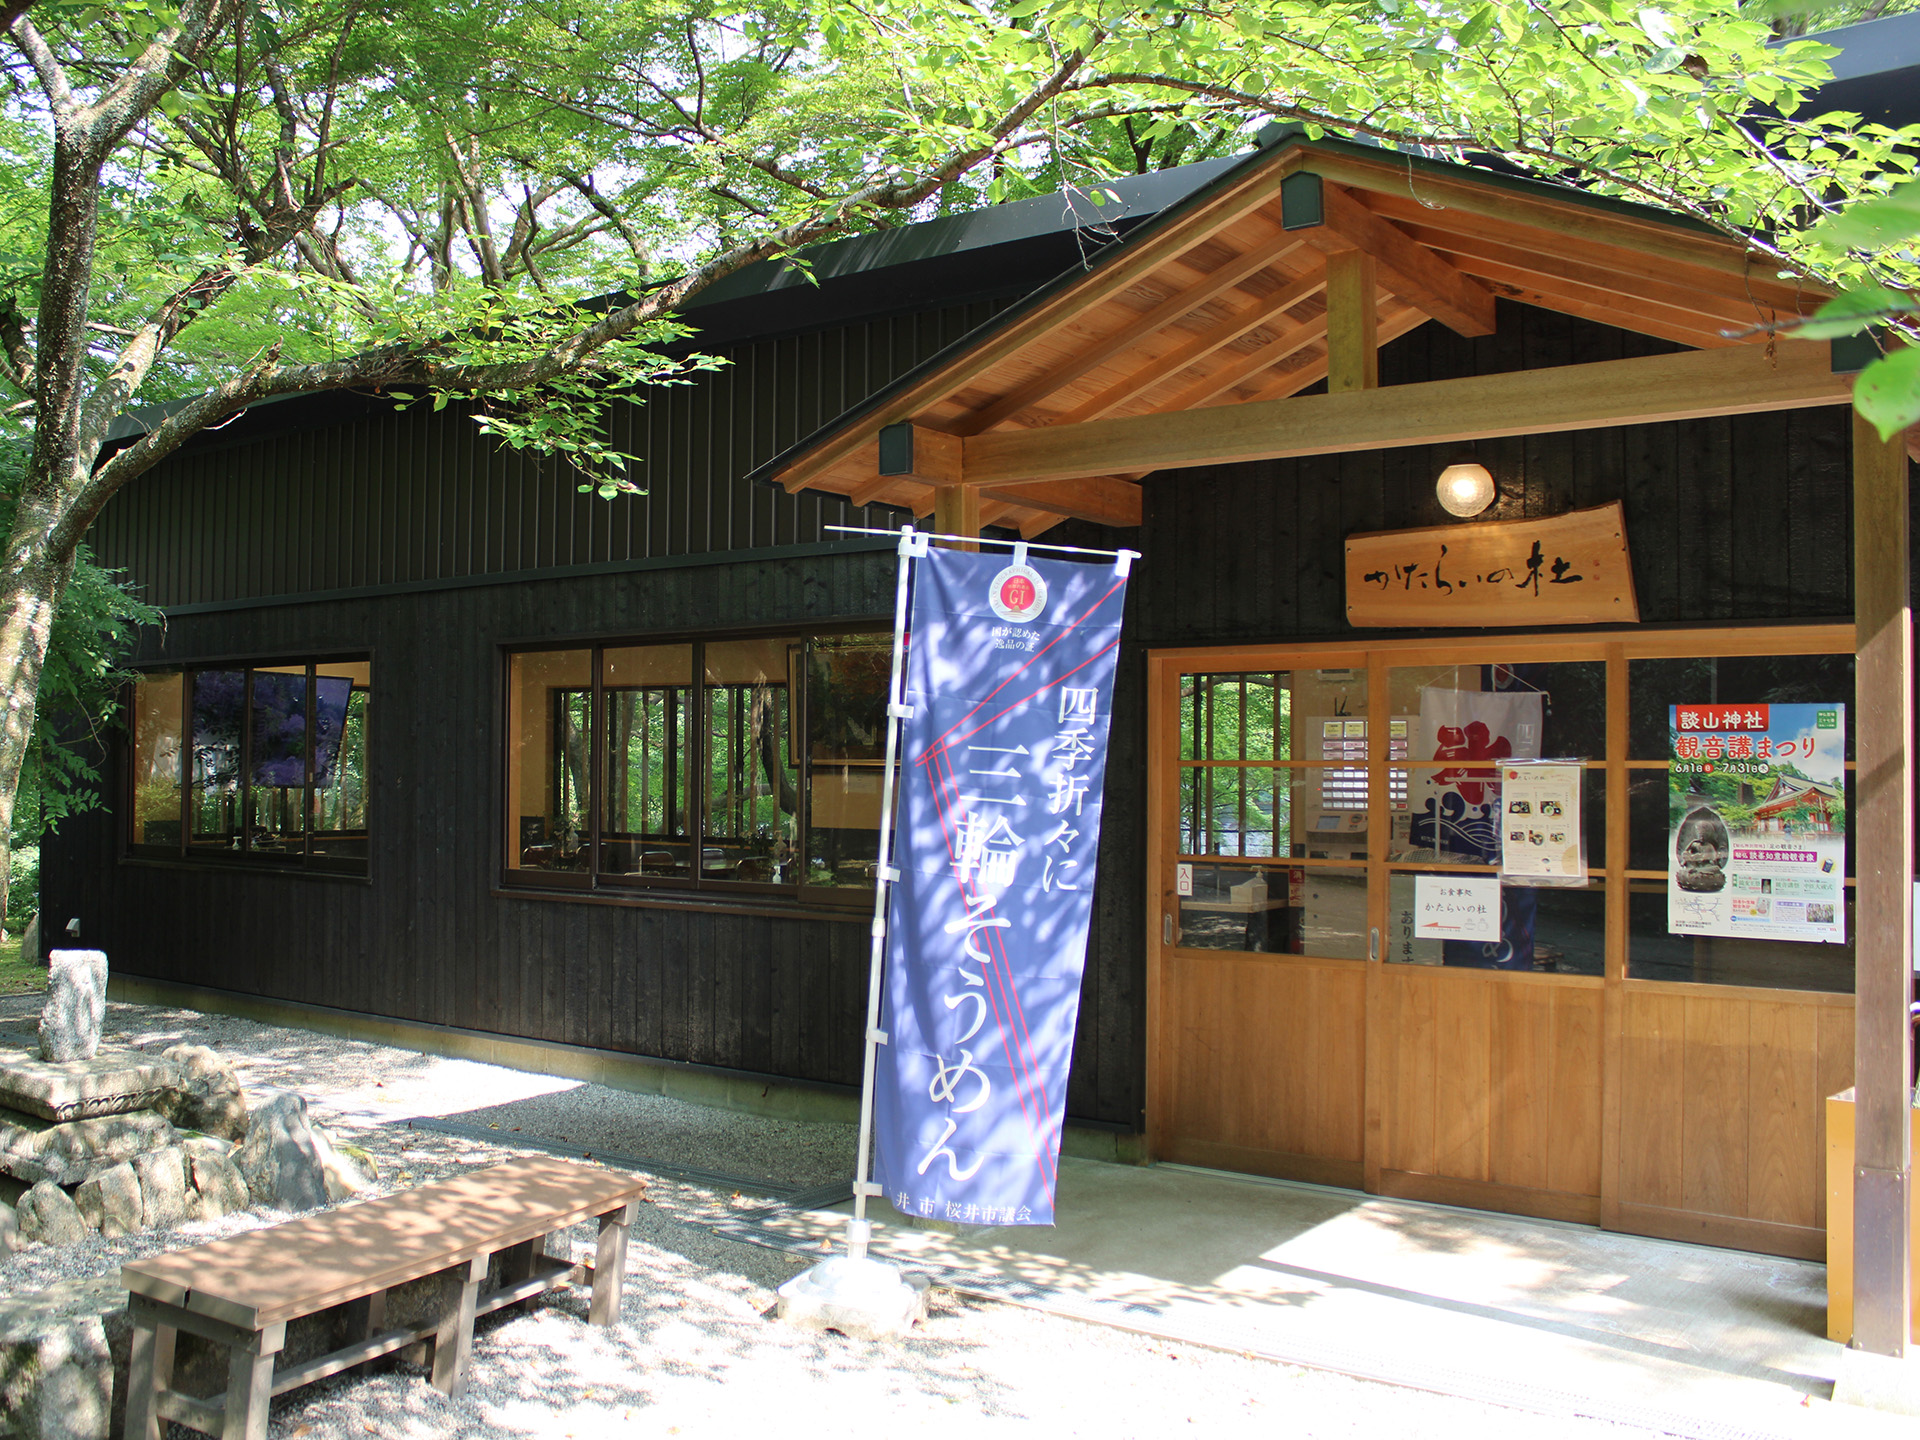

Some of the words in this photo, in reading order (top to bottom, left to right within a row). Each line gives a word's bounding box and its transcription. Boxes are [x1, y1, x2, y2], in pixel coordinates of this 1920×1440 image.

[1009, 589, 1026, 605] GI
[991, 626, 1041, 641] 国が認めた
[994, 638, 1035, 652] 逸品の証
[1680, 711, 1765, 730] 談山神社
[1675, 735, 1817, 759] 観音講まつり
[1043, 685, 1100, 891] 四季折々に
[1179, 867, 1190, 892] 入口
[1439, 887, 1473, 897] お食事処
[1424, 902, 1488, 914] かたらいの杜
[917, 743, 1030, 1182] 三輪そうめん
[944, 1202, 1032, 1222] 桜井市議会
